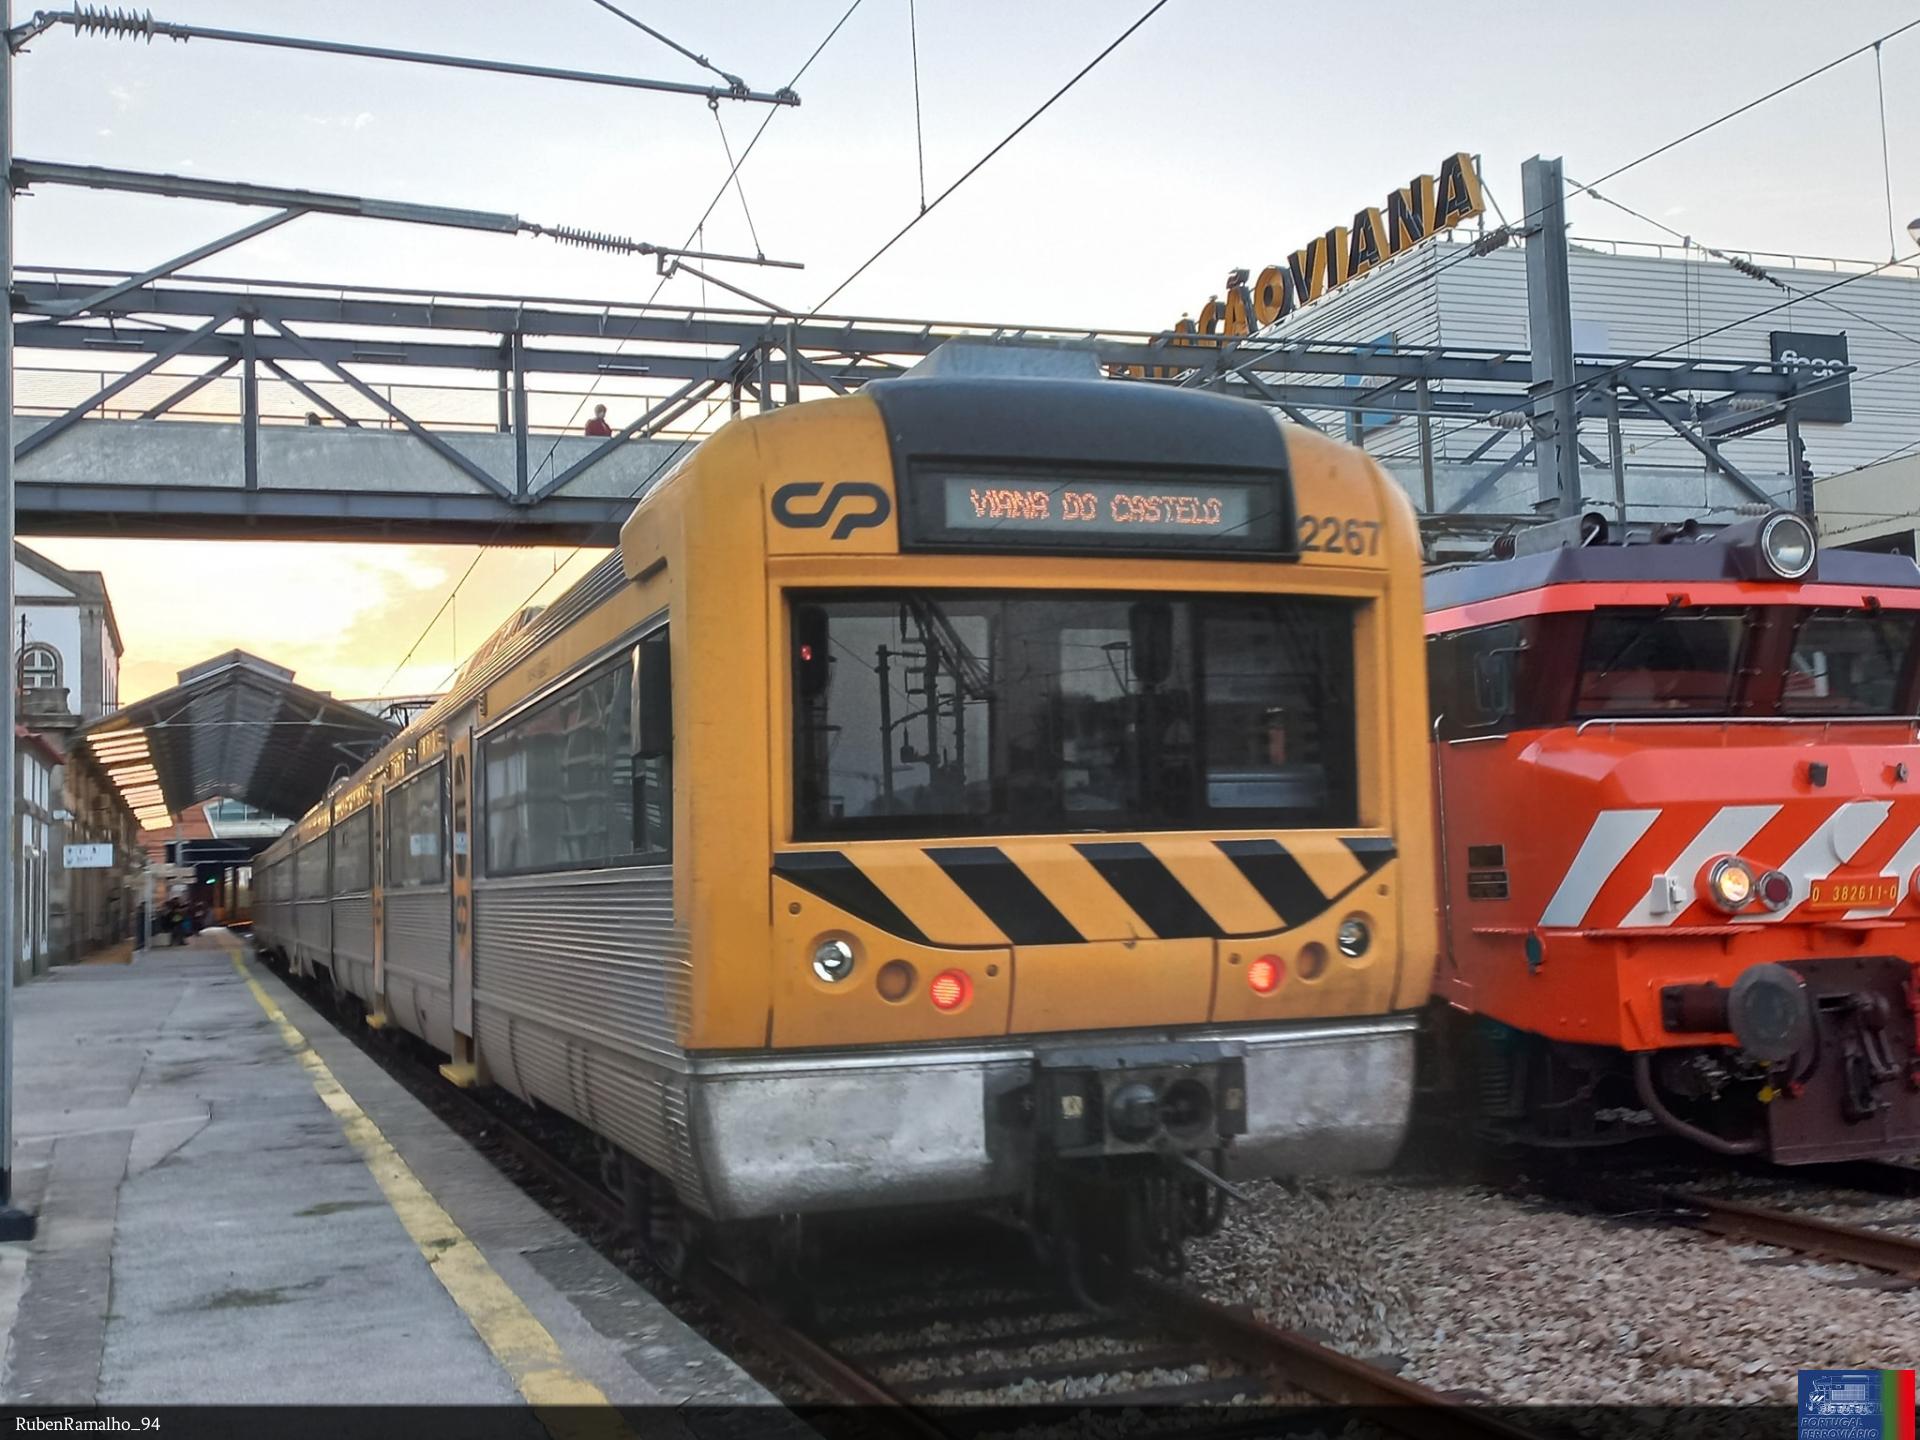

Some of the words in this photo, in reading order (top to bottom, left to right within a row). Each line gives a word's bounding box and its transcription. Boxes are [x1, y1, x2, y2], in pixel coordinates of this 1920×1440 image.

[1287, 152, 1486, 306] VIANA
[970, 488, 1050, 521] VIANA
[1062, 491, 1098, 521] DO
[1111, 494, 1223, 525] CASTELO
[1296, 514, 1381, 557] 2267
[1833, 884, 1898, 901] 382611-0
